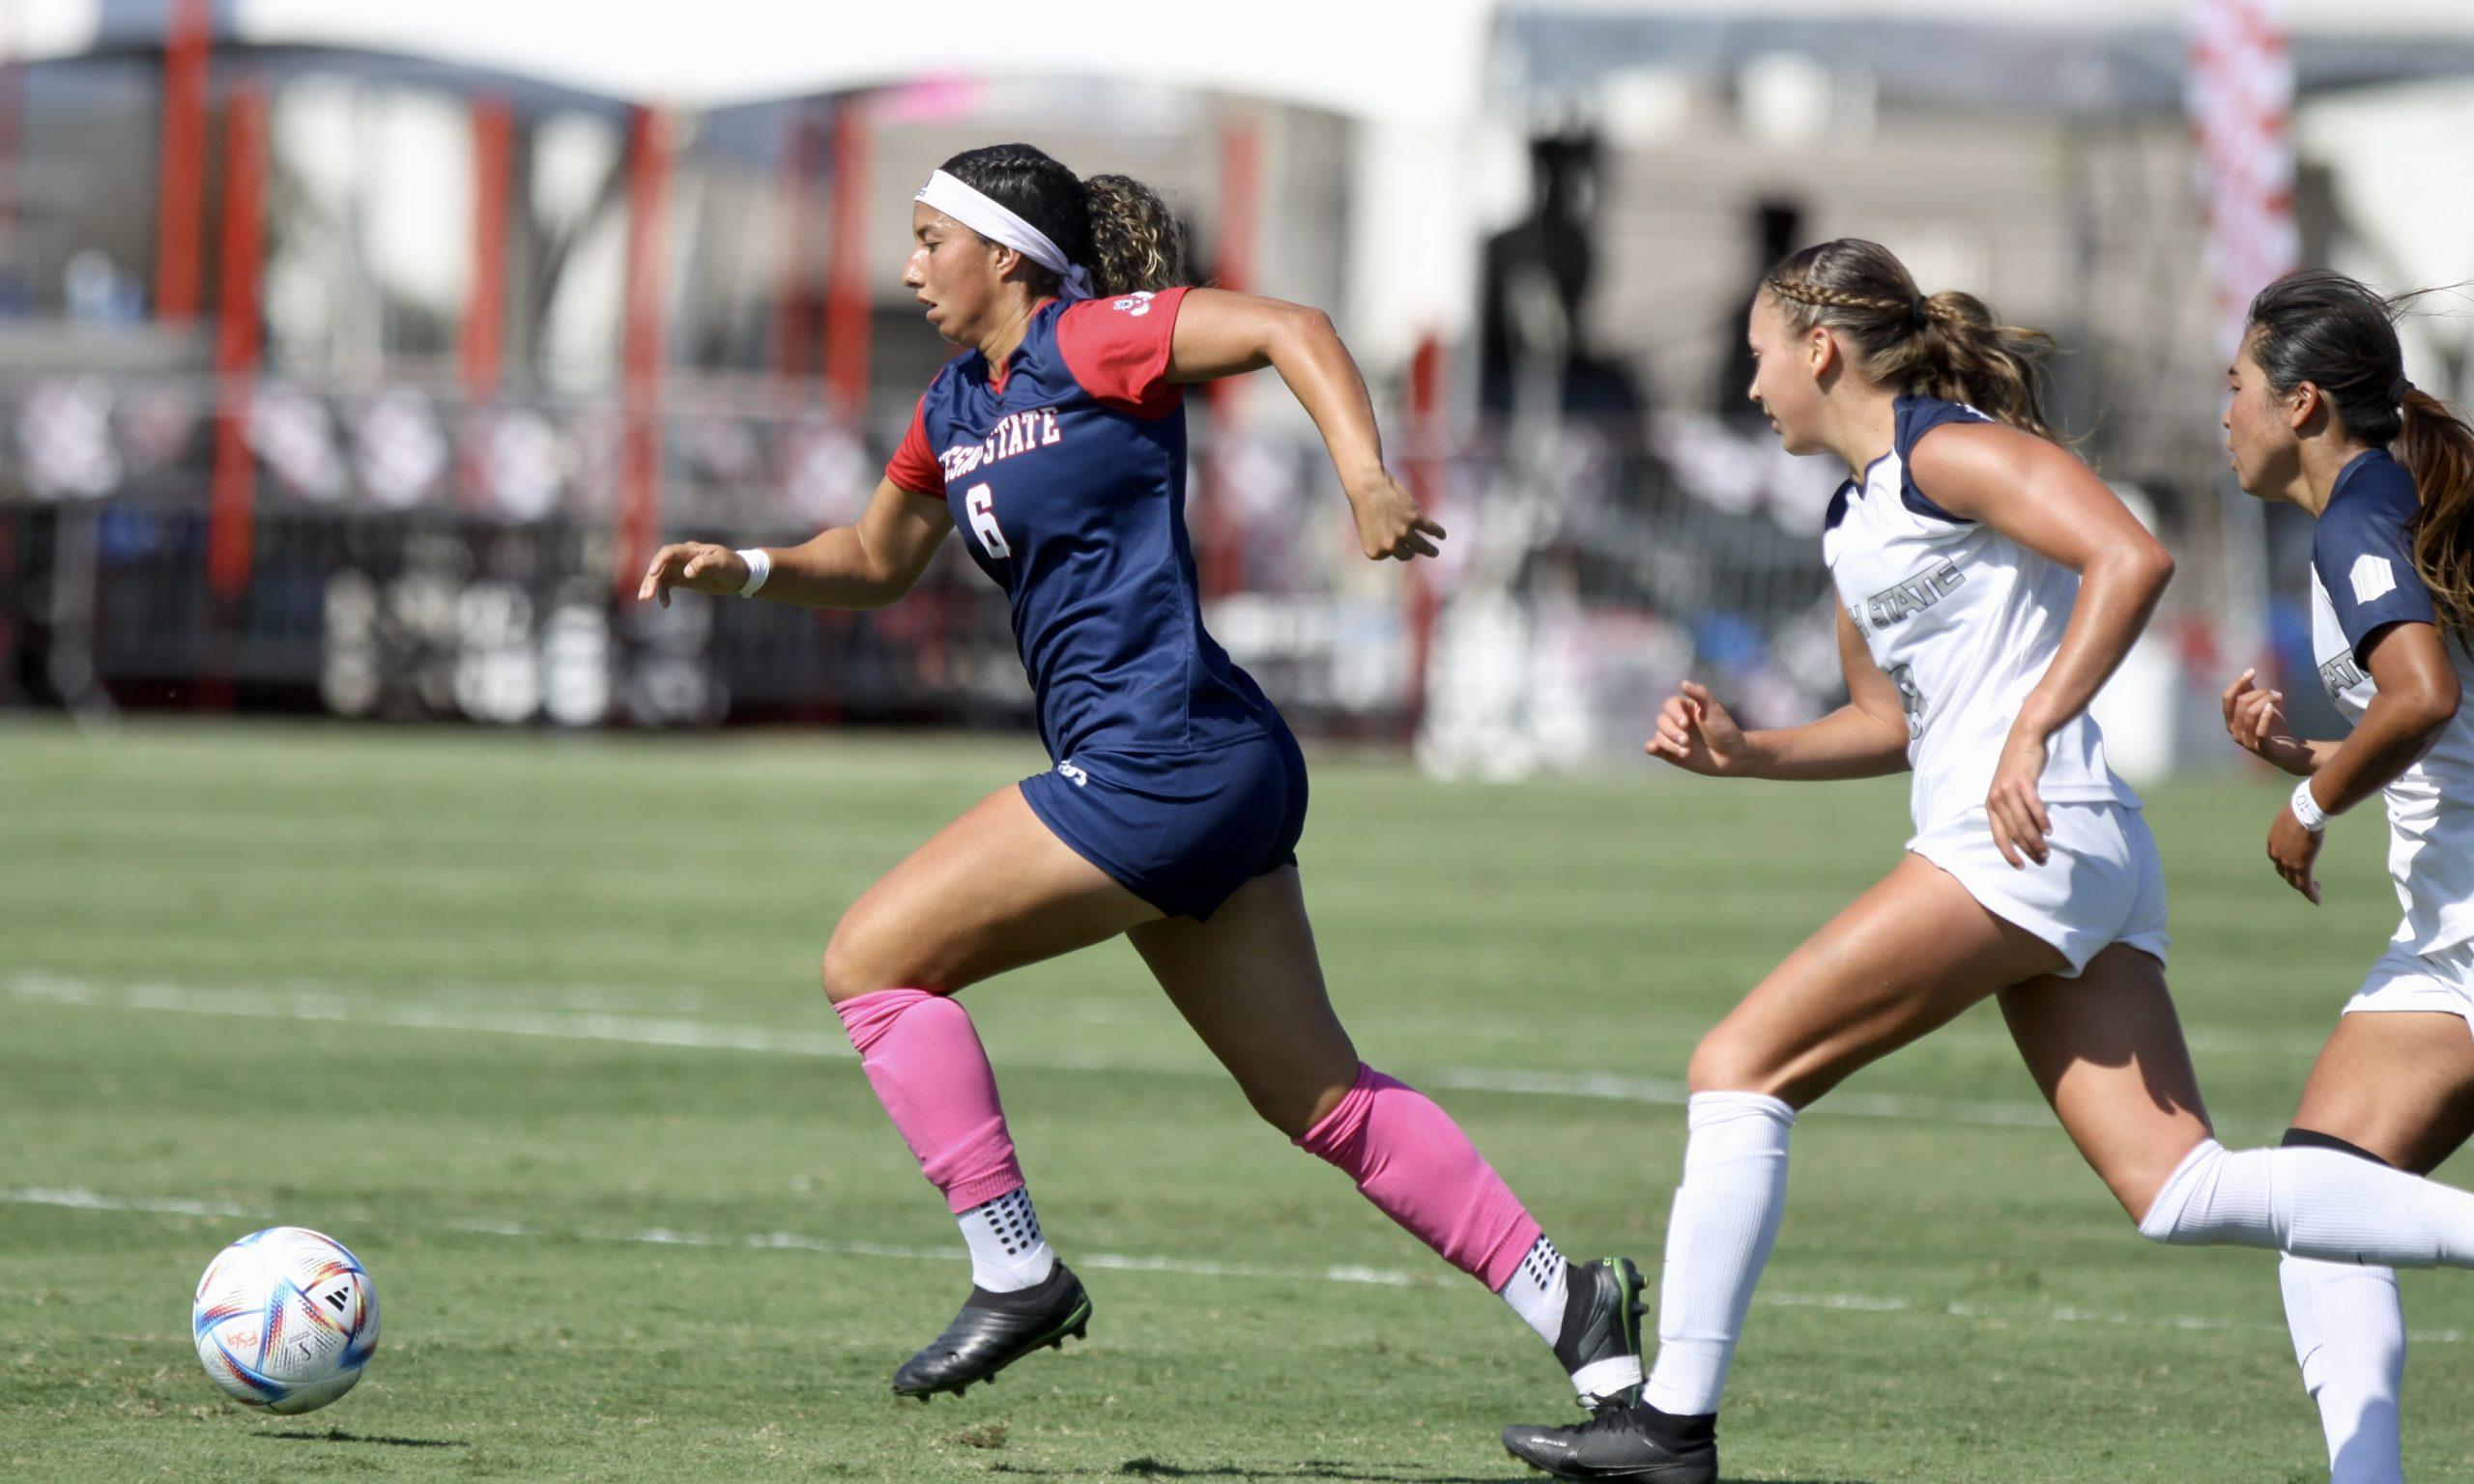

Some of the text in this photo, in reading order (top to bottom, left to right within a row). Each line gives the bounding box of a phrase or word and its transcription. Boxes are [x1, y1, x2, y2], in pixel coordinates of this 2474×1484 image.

[983, 407, 1060, 465] STATE
[965, 482, 1011, 559] 6
[1867, 555, 1967, 631] STATE
